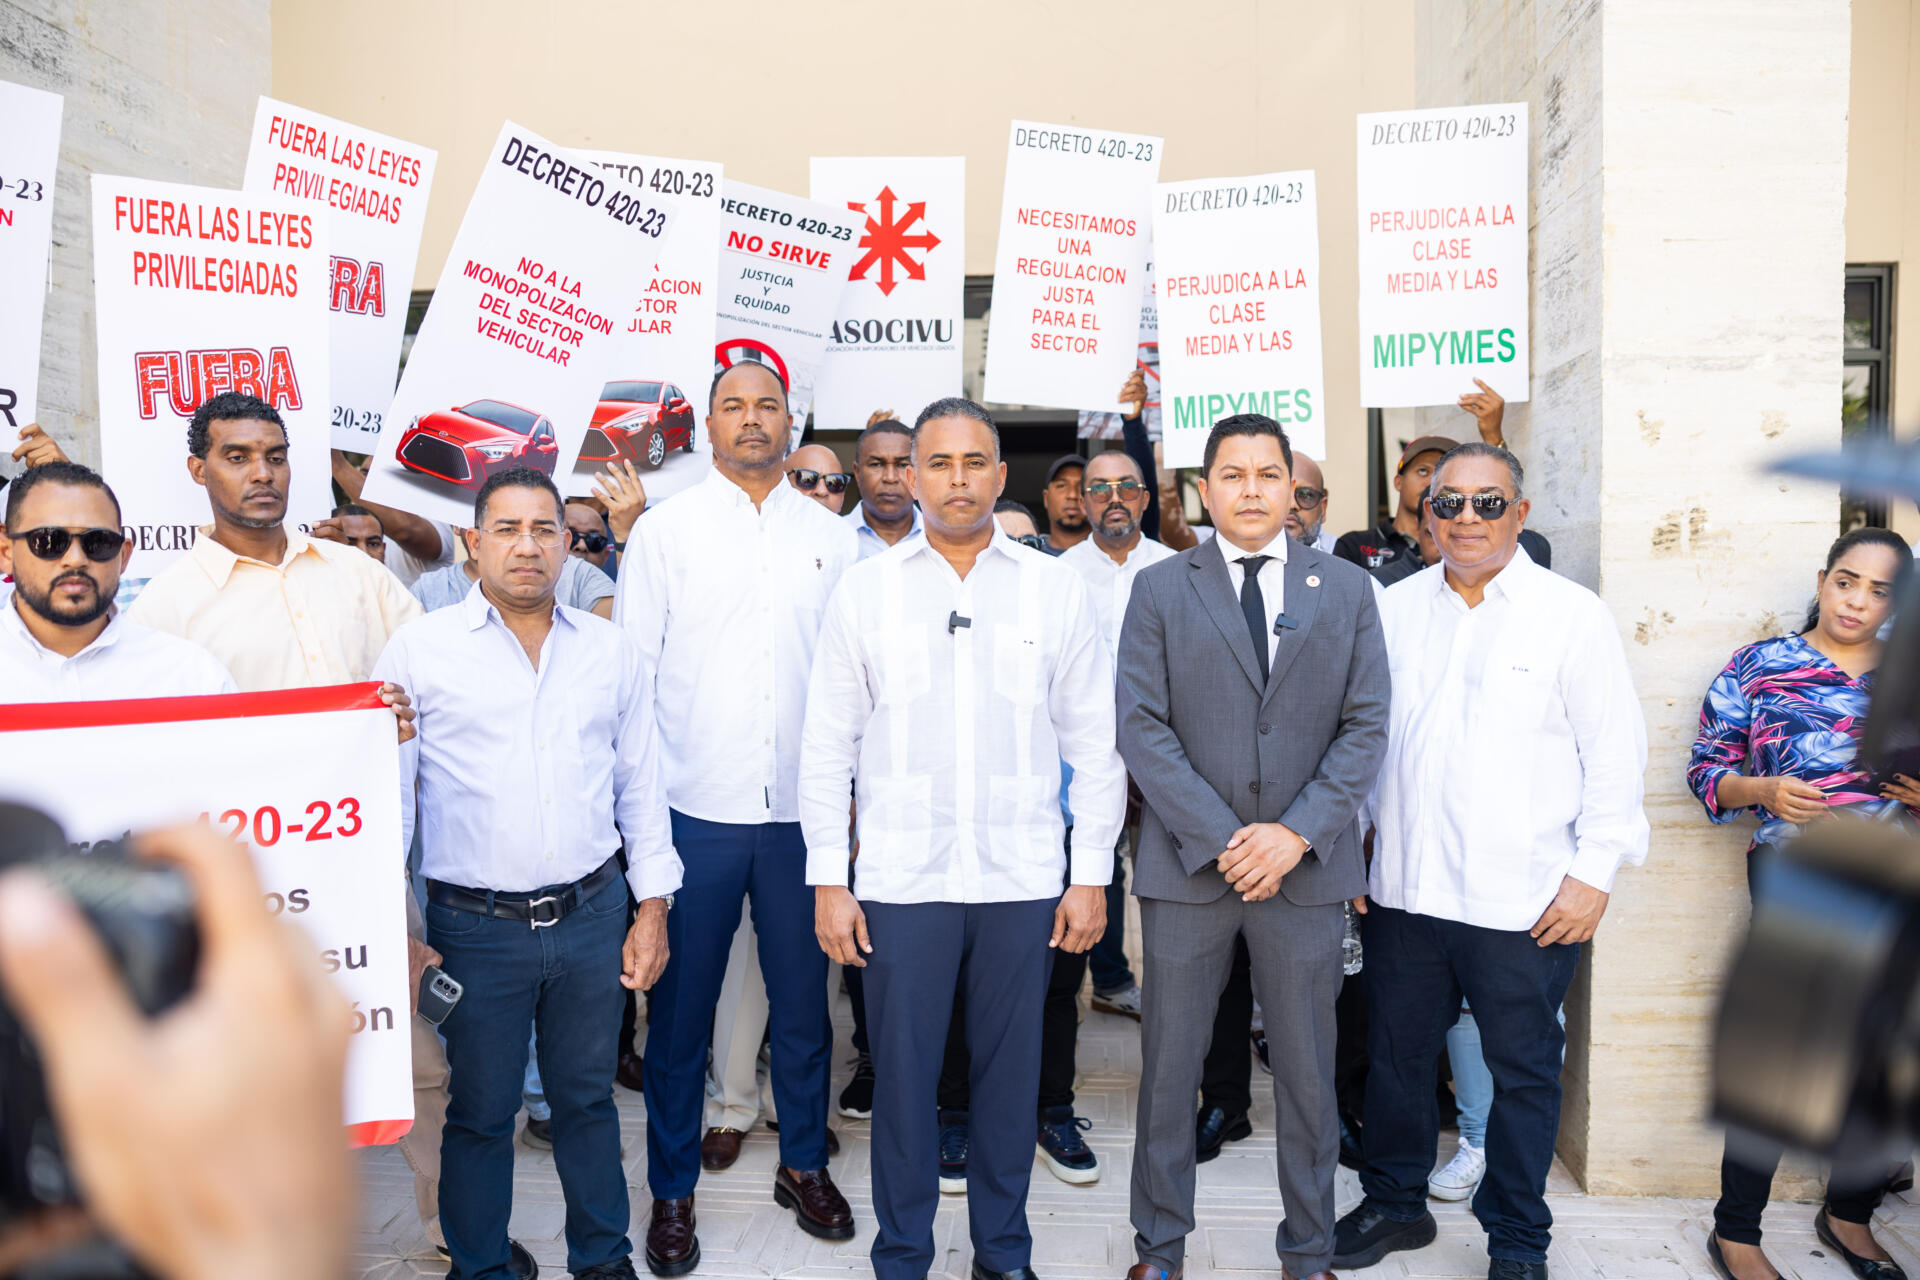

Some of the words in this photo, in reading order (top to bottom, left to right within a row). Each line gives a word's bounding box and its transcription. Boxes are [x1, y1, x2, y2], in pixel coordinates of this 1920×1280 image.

[1015, 128, 1092, 154] DECRETO
[1098, 138, 1153, 162] 420-23
[1372, 118, 1459, 147] DECRETO
[1462, 114, 1516, 139] 420-23
[269, 116, 326, 160] FUERA
[331, 135, 366, 170] LAS
[368, 149, 421, 187] LEYES
[274, 163, 402, 224] PRIVILEGIADAS
[501, 137, 604, 206] DECRETO
[605, 190, 666, 238] 420-23
[650, 168, 714, 198] 420-23
[1165, 186, 1248, 214] DECRETO
[1252, 182, 1303, 206] 420-23
[115, 196, 192, 238] FUERA
[199, 206, 239, 242] LAS
[247, 212, 312, 249] LEYES
[796, 218, 852, 241] 420-23
[1017, 207, 1137, 237] NECESITAMOS
[1370, 207, 1470, 233] PERJUDICA
[1474, 206, 1487, 226] A
[1491, 204, 1515, 226] LA
[727, 230, 763, 253] NO
[768, 240, 832, 269] SIRVE
[1058, 237, 1092, 257] UNA
[1413, 238, 1472, 262] CLASE
[133, 251, 298, 298] PRIVILEGIADAS
[329, 255, 385, 317] RA
[517, 257, 543, 280] NO
[545, 271, 557, 287] A
[561, 275, 582, 298] LA
[740, 267, 794, 288] JUSTICIA
[1017, 258, 1127, 284] REGULACION
[1167, 272, 1264, 298] PERJUDICA
[1267, 271, 1280, 290] A
[1285, 268, 1307, 290] LA
[1387, 272, 1442, 295] MEDIA
[1447, 270, 1460, 290] Y
[1464, 268, 1498, 290] LAS
[463, 260, 614, 335] MONOPOLIZACION
[644, 279, 701, 295] ACION
[763, 286, 771, 296] Y
[1043, 286, 1094, 305] JUSTA
[734, 294, 790, 315] EQUIDAD
[1032, 308, 1076, 329] PARA
[1081, 314, 1101, 331] EL
[1209, 302, 1266, 325] CLASE
[479, 293, 511, 321] DEL
[516, 307, 584, 348] SECTOR
[829, 319, 952, 343] ASOCIVU
[476, 317, 571, 367] VEHICULAR
[1030, 333, 1098, 355] SECTOR
[1186, 334, 1240, 357] MEDIA
[1245, 333, 1257, 353] Y
[1260, 330, 1293, 352] LAS
[1373, 328, 1516, 369] MIPYMES
[135, 346, 302, 419] FUERA
[331, 405, 382, 434] 20-23
[1174, 388, 1312, 429] MIPYMES
